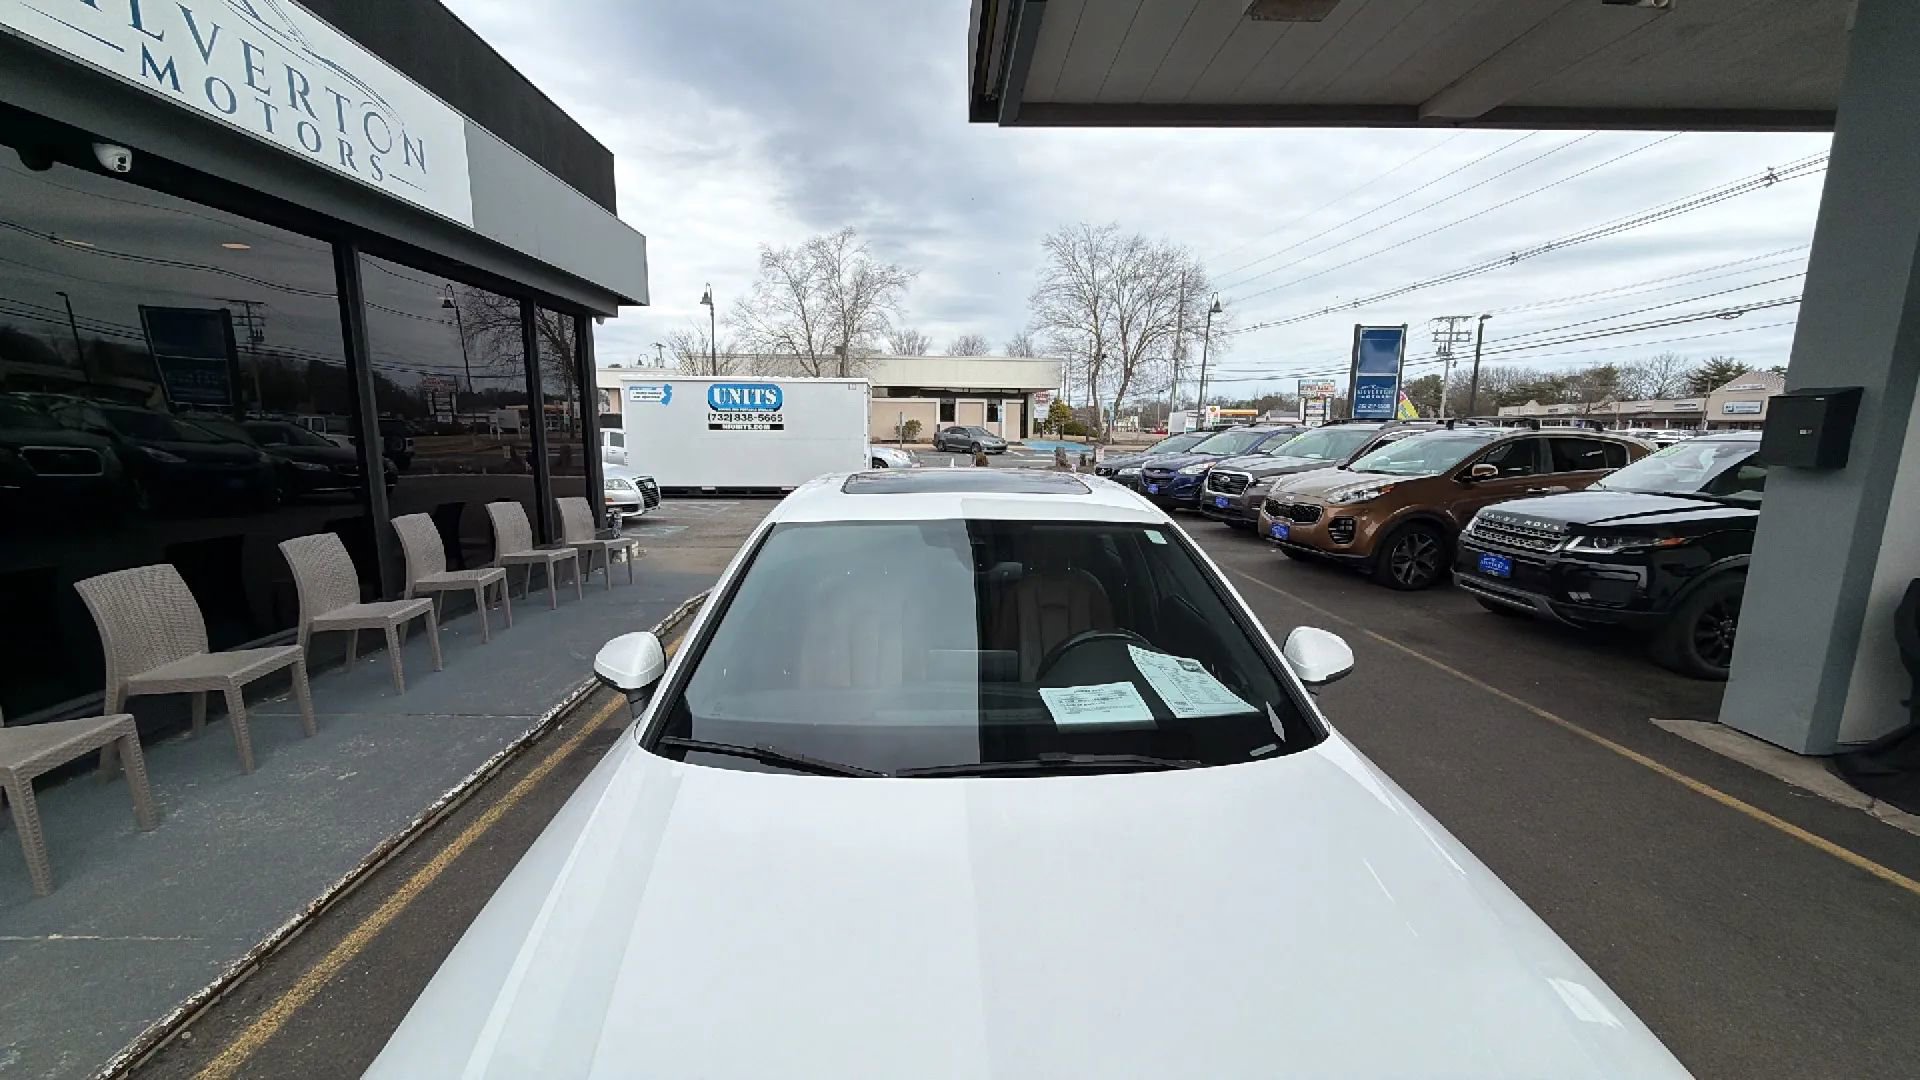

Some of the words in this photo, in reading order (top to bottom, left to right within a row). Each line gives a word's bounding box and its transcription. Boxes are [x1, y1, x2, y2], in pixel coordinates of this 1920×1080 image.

[80, 0, 428, 174] LVERTON
[140, 42, 384, 182] MOTORS
[713, 388, 777, 405] UNITS
